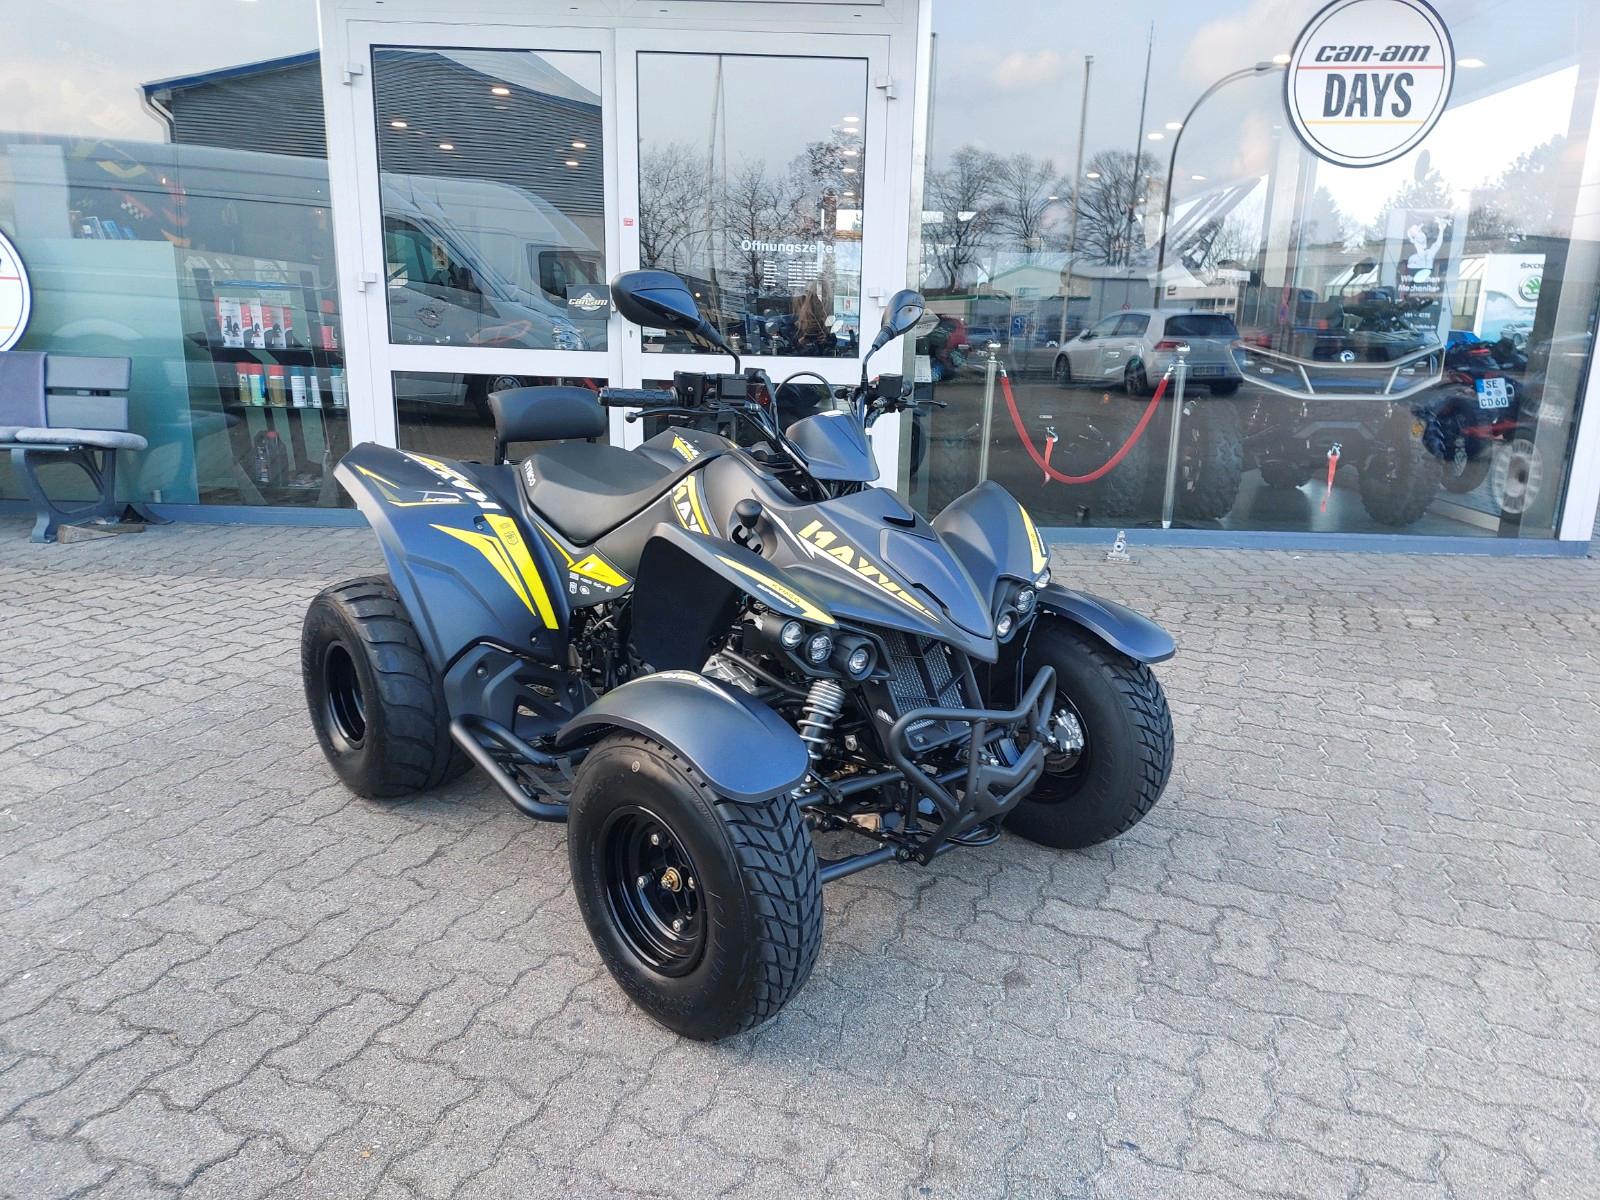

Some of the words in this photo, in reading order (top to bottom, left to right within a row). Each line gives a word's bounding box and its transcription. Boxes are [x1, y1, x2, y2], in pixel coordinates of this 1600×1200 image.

[1314, 45, 1431, 62] can-am
[1322, 72, 1414, 118] DAYS
[1485, 380, 1499, 389] SE
